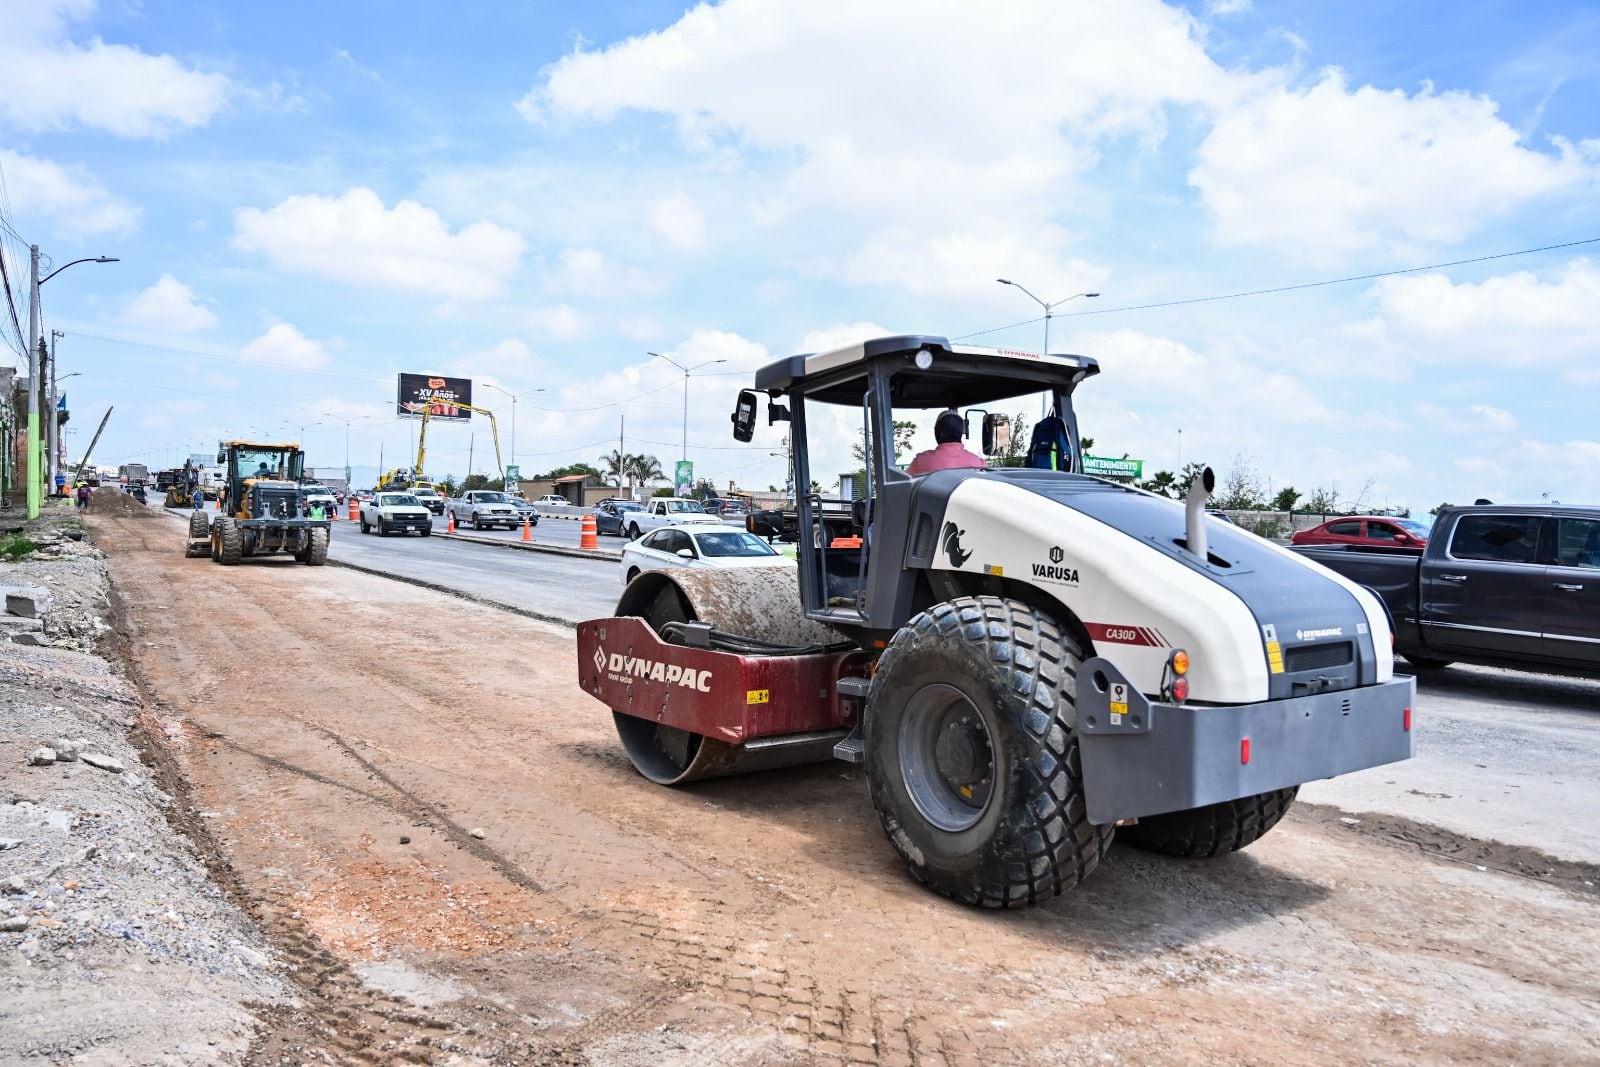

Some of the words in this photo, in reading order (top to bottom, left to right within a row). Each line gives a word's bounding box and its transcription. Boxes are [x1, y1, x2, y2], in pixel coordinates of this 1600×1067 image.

[419, 388, 432, 397] XV
[1032, 564, 1079, 582] VARUSA
[1106, 628, 1136, 641] CA30D
[1303, 627, 1342, 638] DYNAPAC
[608, 653, 712, 692] DYNAPAC
